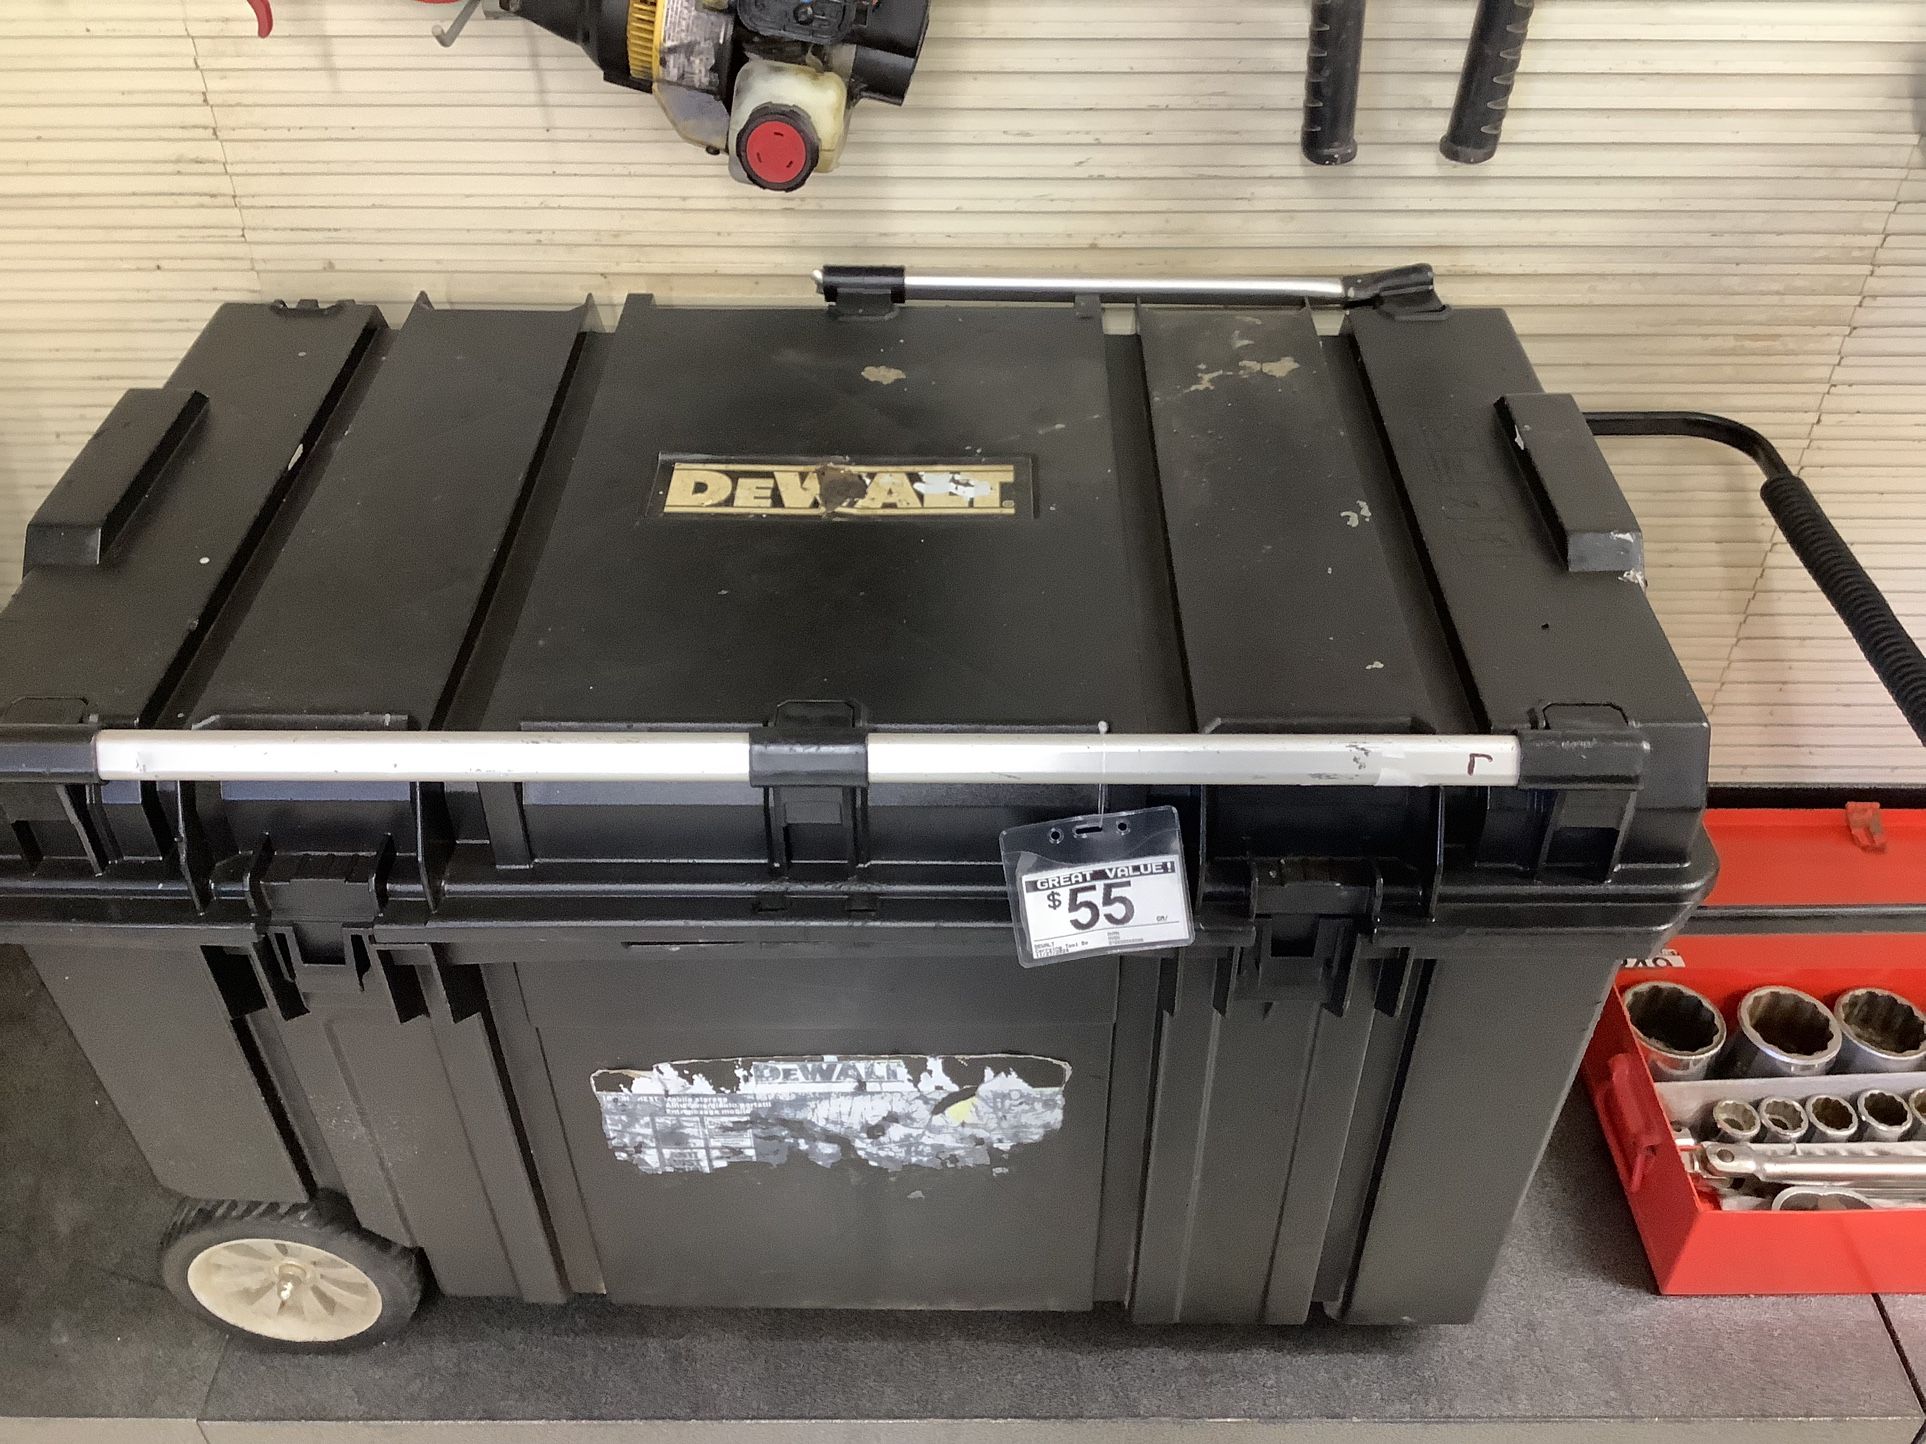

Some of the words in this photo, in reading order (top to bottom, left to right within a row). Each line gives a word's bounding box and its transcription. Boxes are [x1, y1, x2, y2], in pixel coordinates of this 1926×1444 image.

[1036, 870, 1094, 891] GREAT
[1105, 862, 1174, 880] VALUE!
[1047, 880, 1135, 931] $55
